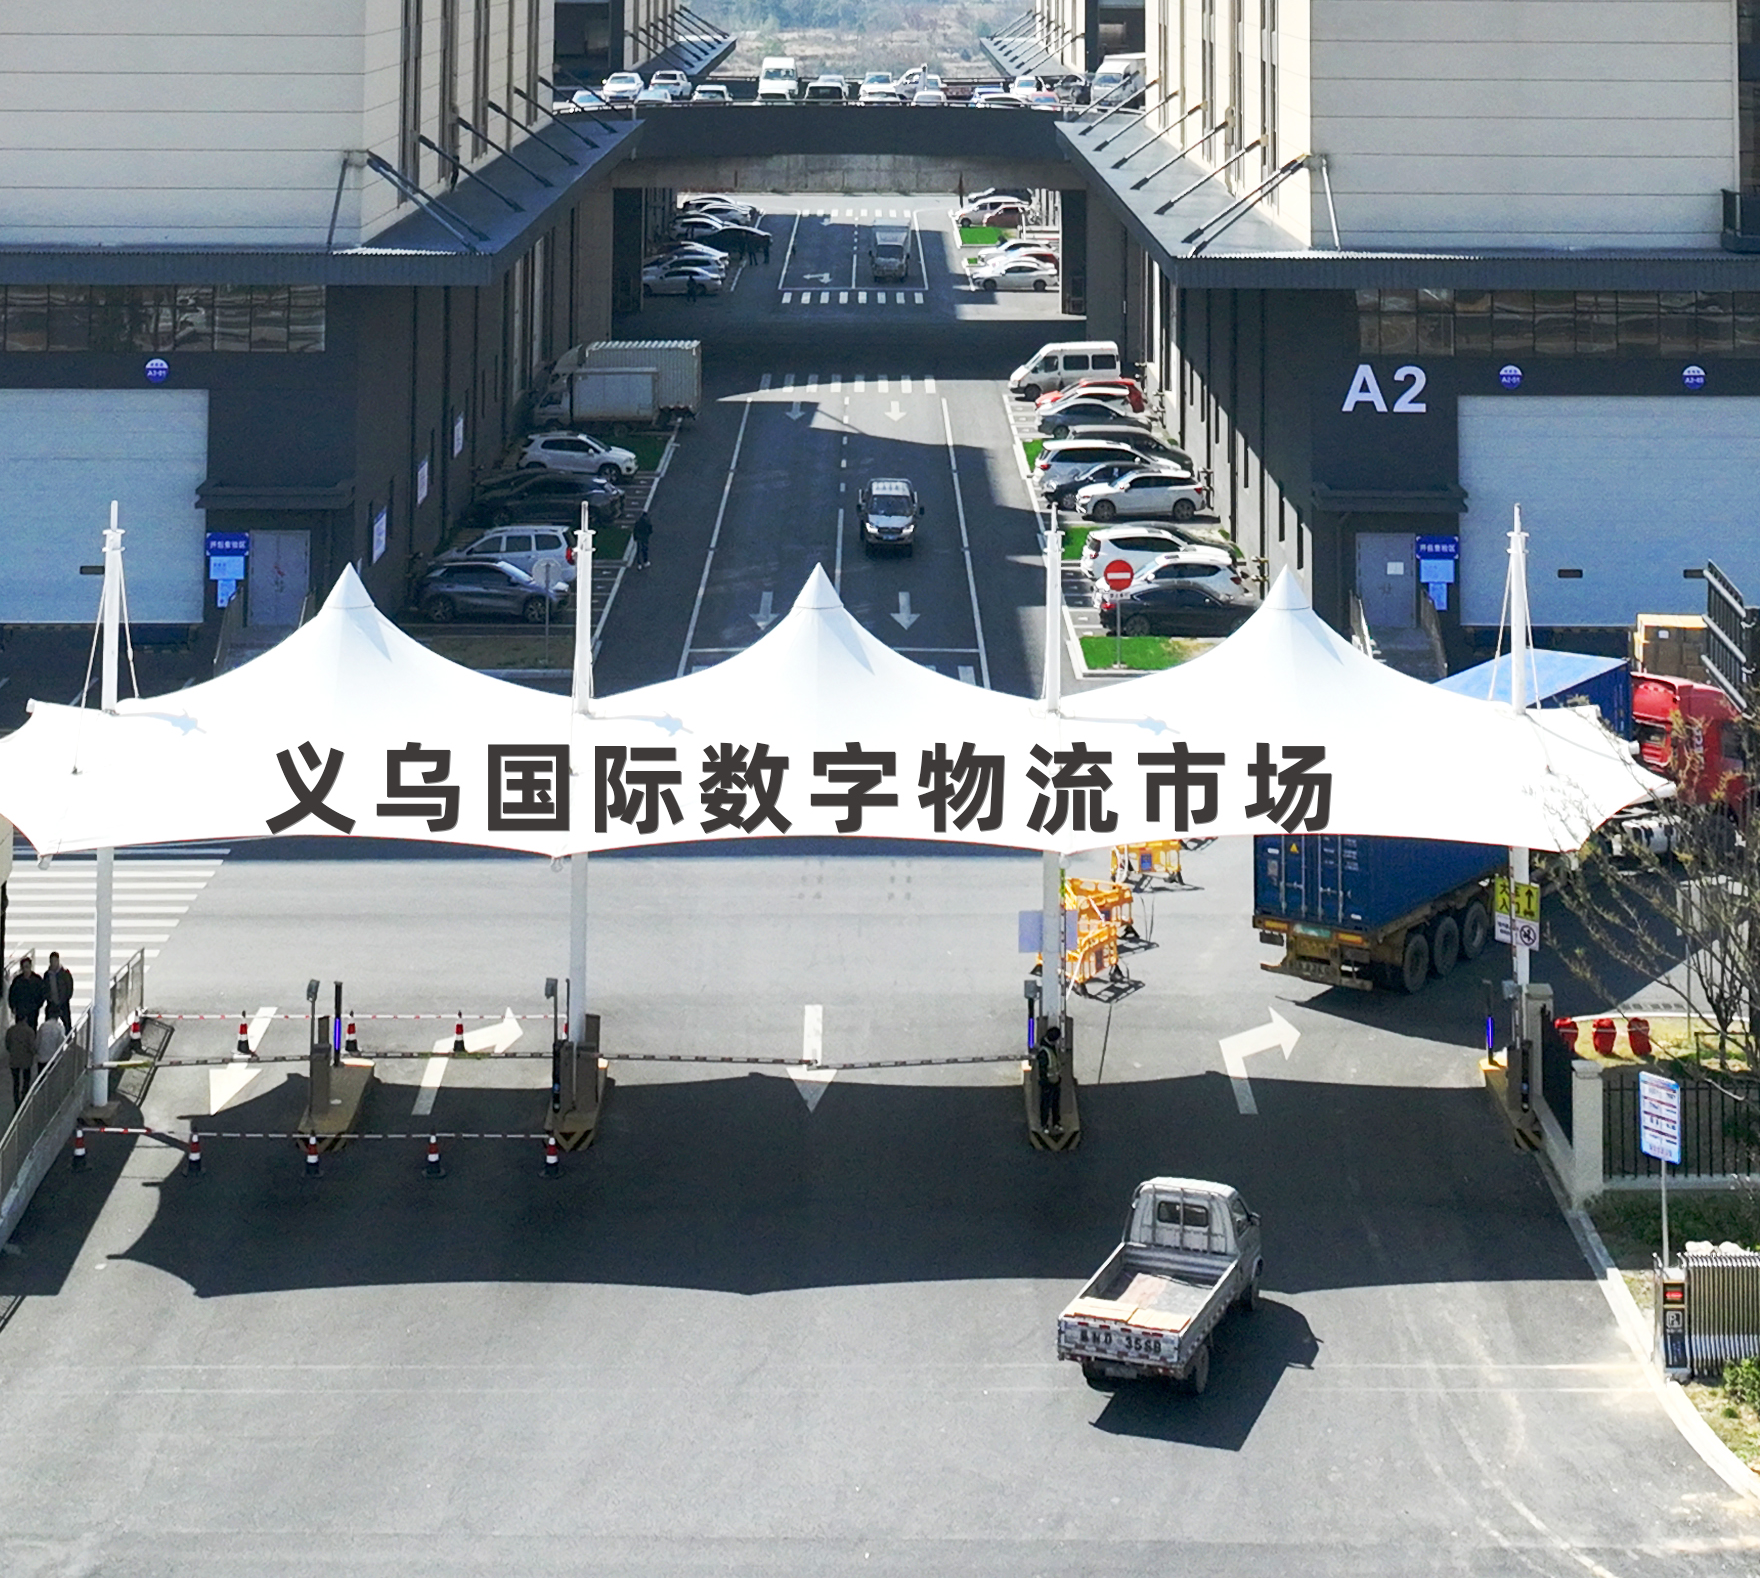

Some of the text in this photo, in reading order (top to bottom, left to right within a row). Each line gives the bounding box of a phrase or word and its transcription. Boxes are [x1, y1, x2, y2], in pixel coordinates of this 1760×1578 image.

[1342, 364, 1427, 413] A2
[265, 740, 1332, 834] 义乌国际数字物流市场
